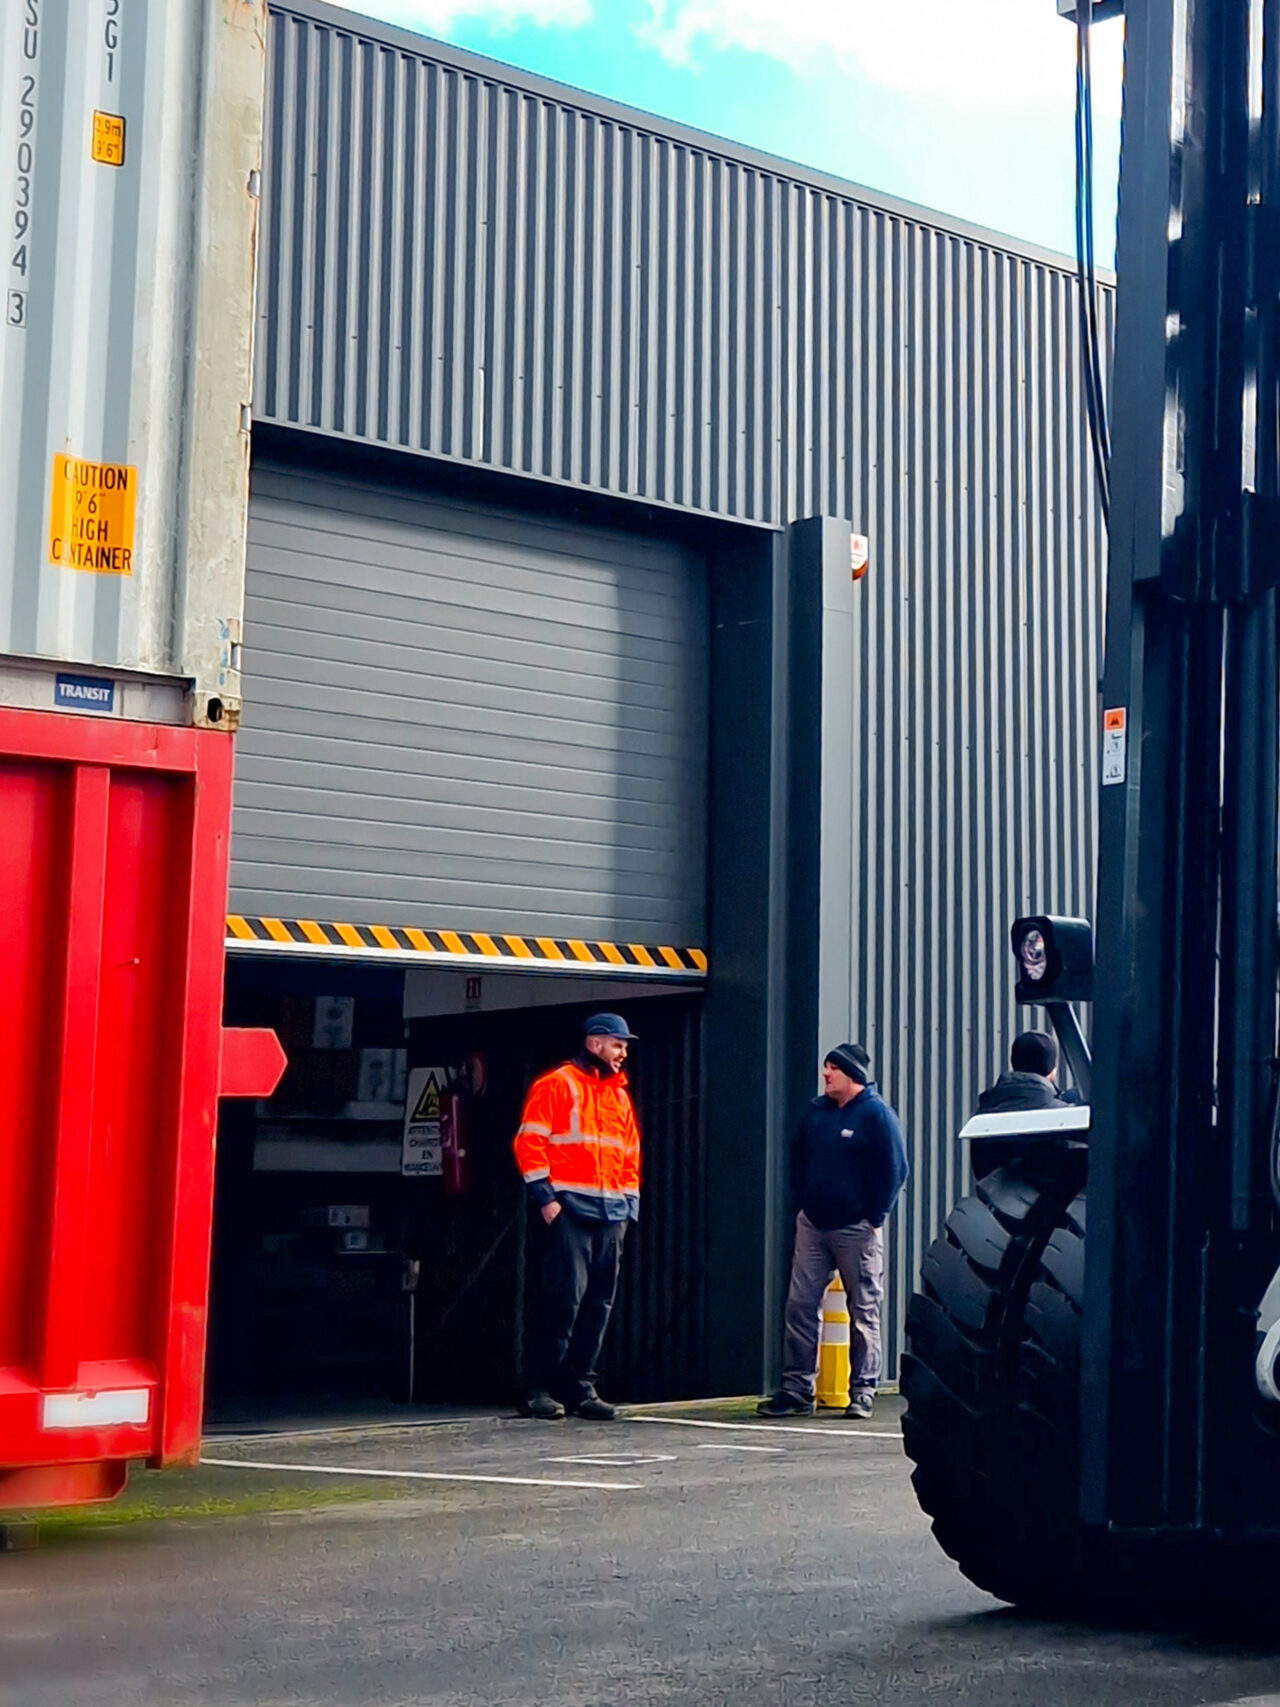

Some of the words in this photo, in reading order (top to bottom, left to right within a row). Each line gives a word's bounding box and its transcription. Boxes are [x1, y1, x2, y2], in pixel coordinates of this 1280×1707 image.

[11, 75, 36, 277] 290394
[9, 292, 25, 325] 3
[64, 459, 128, 491] CAUTION
[71, 516, 108, 543] HIGH
[51, 537, 132, 570] CNTAINER
[58, 682, 110, 701] TRANSIT
